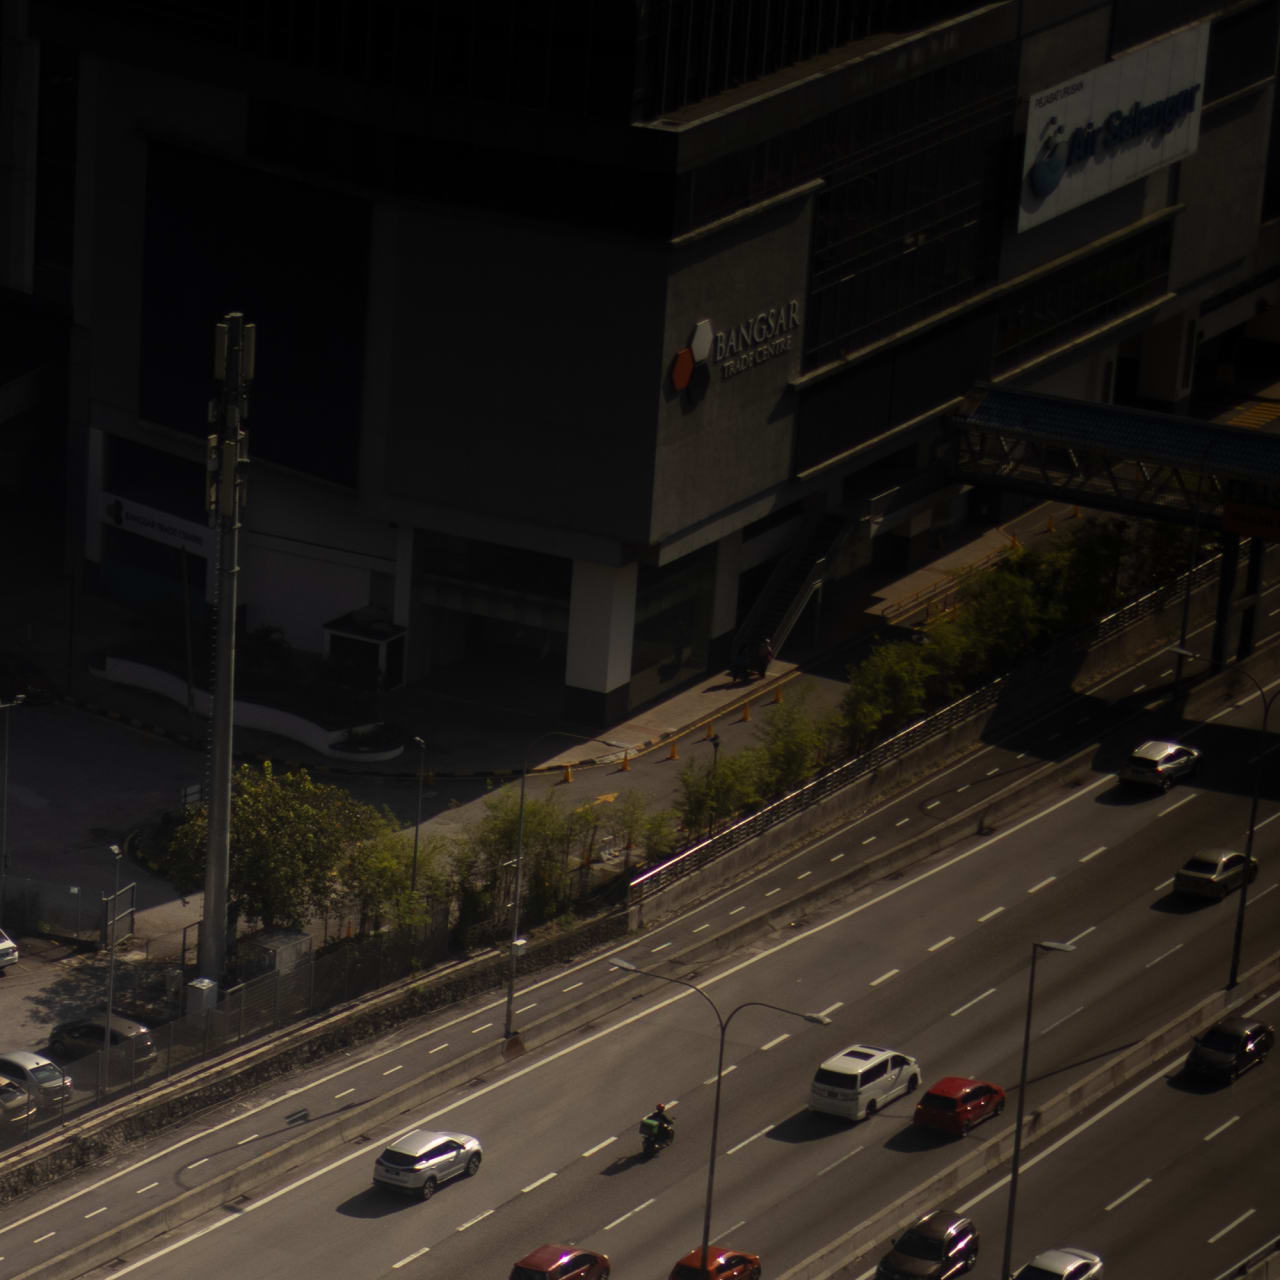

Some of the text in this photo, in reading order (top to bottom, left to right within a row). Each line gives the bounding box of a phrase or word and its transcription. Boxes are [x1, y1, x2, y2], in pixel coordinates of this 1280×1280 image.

[1066, 83, 1201, 166] Air Selangor
[714, 299, 801, 361] BANGSAR
[723, 335, 793, 379] TRADE CENTRE
